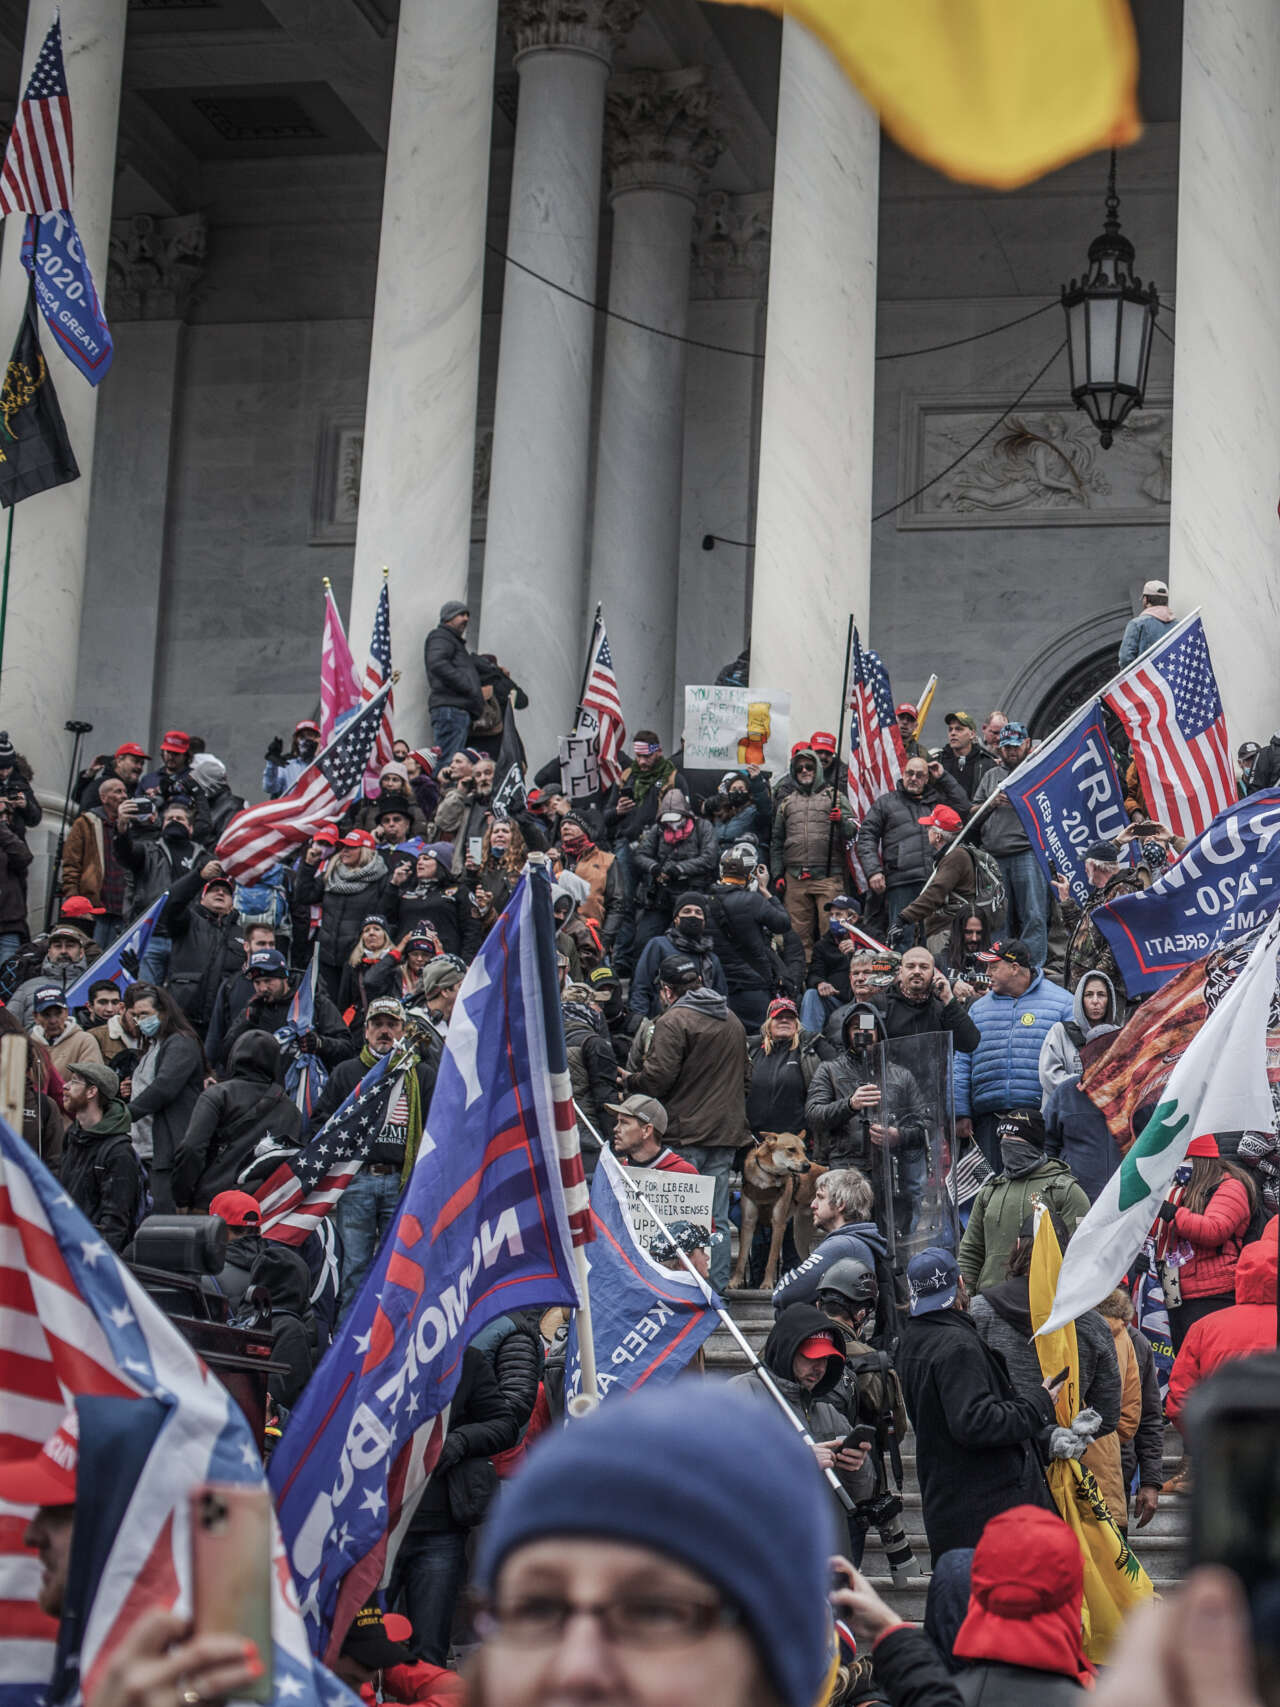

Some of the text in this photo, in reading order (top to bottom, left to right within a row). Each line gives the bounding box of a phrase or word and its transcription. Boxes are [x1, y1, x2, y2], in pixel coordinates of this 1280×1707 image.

[59, 310, 100, 356] GREAT!
[1035, 791, 1077, 883] KEEP AMERICA
[644, 1180, 658, 1191] FOR
[662, 1182, 701, 1194] LIBERAL
[673, 1194, 686, 1203] TO
[680, 1205, 710, 1216] SENSES
